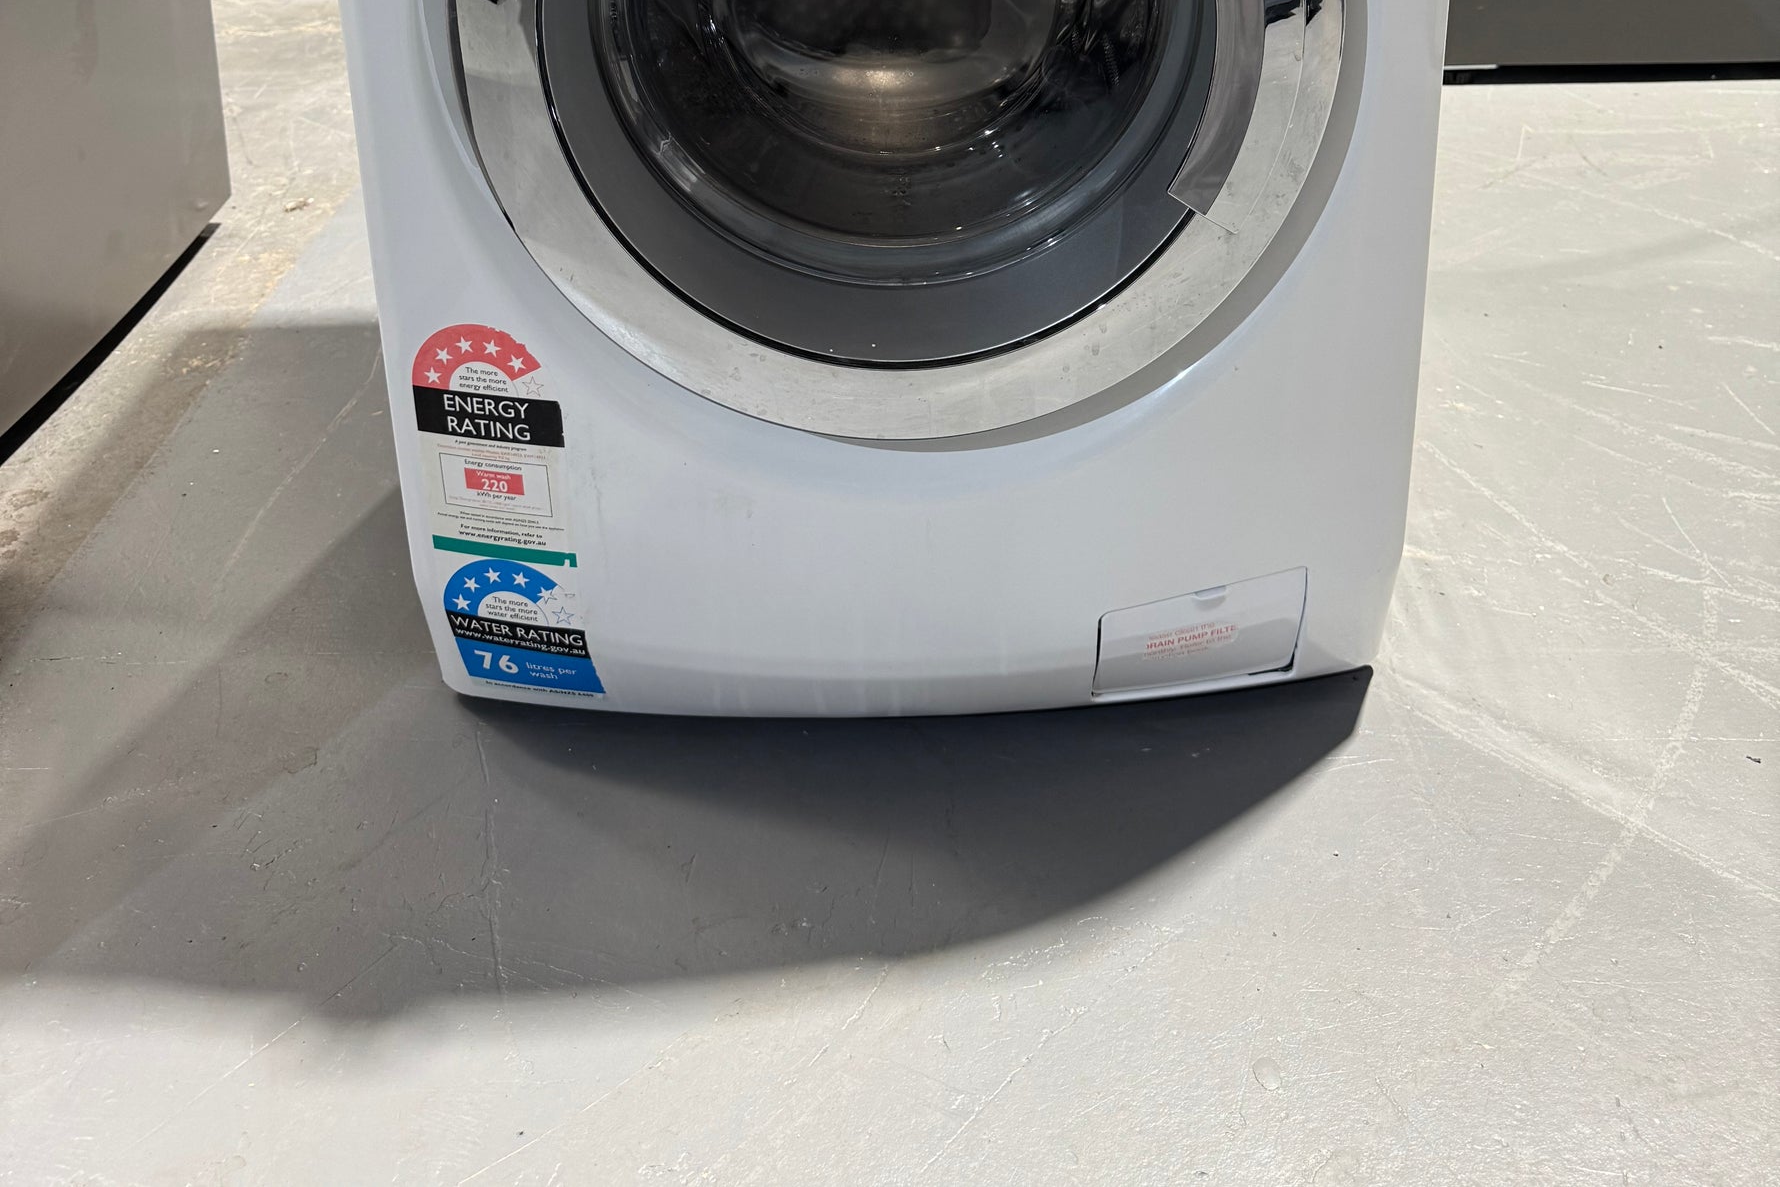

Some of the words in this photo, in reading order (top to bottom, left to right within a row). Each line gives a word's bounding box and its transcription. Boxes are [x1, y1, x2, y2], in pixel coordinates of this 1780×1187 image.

[465, 366, 478, 374] The
[459, 383, 481, 391] energy
[443, 393, 529, 419] ENERGY
[447, 415, 531, 441] RATING
[464, 458, 484, 467] Energy
[484, 462, 522, 471] consumption
[481, 478, 508, 492] 220
[487, 527, 521, 536] information,
[458, 530, 546, 547] www.energyrating.gov.au
[492, 596, 507, 604] The
[487, 610, 507, 618] water
[510, 613, 538, 622] efficient
[451, 614, 512, 635] WATER
[516, 627, 583, 646] RATING
[455, 628, 586, 655] www.waterrating.gov.au
[1177, 632, 1208, 643] PUMP
[474, 649, 519, 674] 76
[526, 662, 555, 673] litres
[558, 668, 577, 676] per
[530, 670, 558, 680] wash
